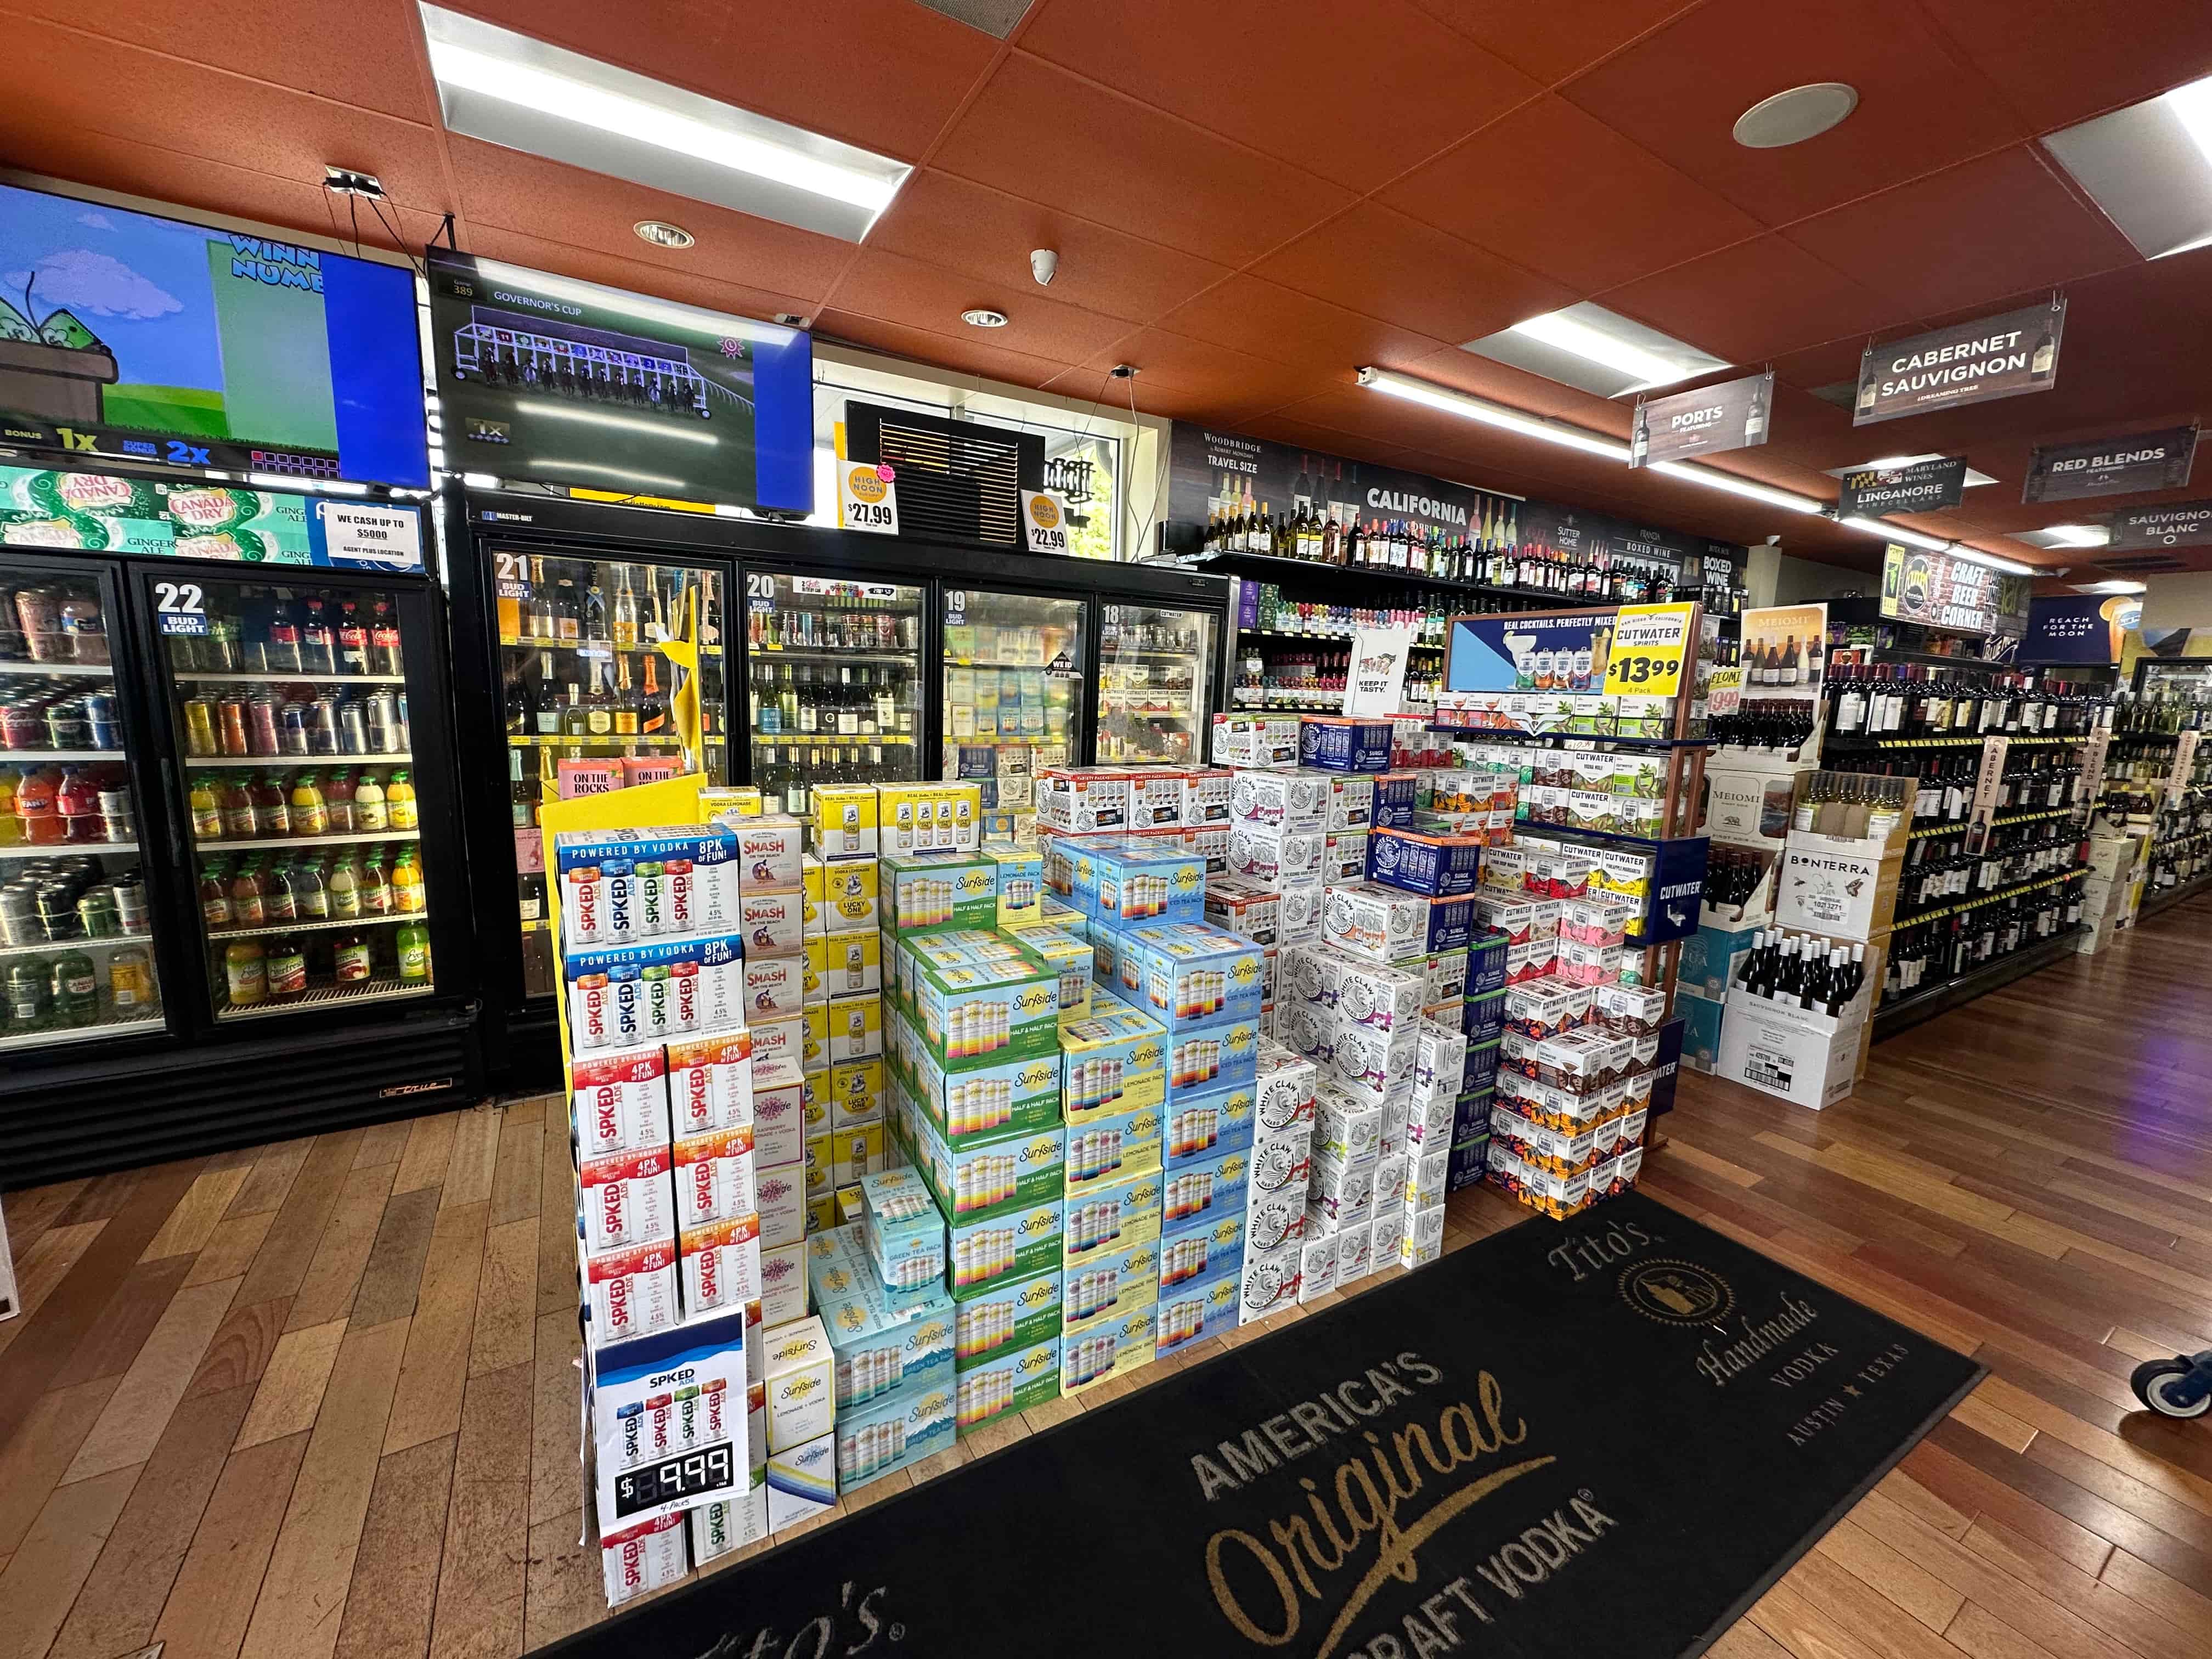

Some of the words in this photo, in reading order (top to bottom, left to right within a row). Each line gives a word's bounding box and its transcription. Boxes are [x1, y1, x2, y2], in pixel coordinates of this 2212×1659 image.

[453, 285, 473, 296] 389
[494, 291, 560, 312] GOVERNOR'S
[562, 306, 582, 316] CUP
[1892, 330, 2022, 374] CABERNET
[1881, 352, 2027, 397] SAUVIGNON
[1672, 405, 1723, 428] PORTS
[4, 429, 42, 439] BONUS
[1679, 421, 1712, 433] FEATURING
[123, 441, 156, 449] SUPER
[123, 447, 157, 455] BONUS
[1204, 432, 1261, 453] WOODBRIDGE
[1207, 454, 1239, 470] TRAVEL
[1239, 461, 1258, 474] SIZE
[1905, 461, 1957, 474] MARYLAND
[2052, 459, 2087, 472] RED
[2091, 448, 2166, 467] BLENDS
[855, 476, 881, 485] HIGH
[1905, 473, 1934, 482] WINES
[61, 481, 132, 499] CANADA
[853, 484, 883, 493] NOON
[1857, 484, 1944, 503] LINGANORE
[168, 496, 237, 514] CANADA
[1034, 504, 1054, 512] HIGH
[1367, 488, 1466, 526] CALIFORNIA
[191, 508, 224, 521] DRY
[337, 514, 352, 523] WE
[354, 515, 377, 526] CASH
[379, 517, 392, 527] UP
[393, 518, 404, 528] TO
[848, 503, 892, 525] $27.99
[1034, 511, 1056, 520] NOON
[2129, 510, 2212, 525] SAUVIGNO
[357, 528, 388, 539] $5000
[1558, 526, 1580, 538] SUTTER
[2146, 523, 2199, 535] BLANC
[127, 537, 175, 548] GINGER
[1031, 528, 1065, 548] $22.99
[1559, 536, 1577, 546] HOME
[377, 548, 404, 556] LOCATION
[1627, 542, 1651, 555] BOXED
[1653, 546, 1671, 558] WINE
[496, 552, 529, 580] 21
[1703, 556, 1731, 573] BOXED
[1706, 570, 1729, 586] WINE
[1951, 561, 1987, 587] CRAFT
[498, 589, 530, 597] LIGHT
[747, 574, 774, 598] 20
[155, 583, 204, 613] 22
[945, 591, 966, 612] 19
[1951, 583, 1979, 607] BEER
[167, 616, 199, 625] BUD
[1103, 605, 1119, 623] 18
[1160, 610, 1183, 618] CUTWATER
[1758, 616, 1808, 627] MEIOMI
[1940, 605, 1984, 630] CORNER
[163, 623, 206, 634] LIGHT
[1504, 622, 1519, 630] REAL
[1519, 619, 1555, 629] COCKTAILS.
[1556, 617, 1592, 628] PERFECTLY
[1617, 628, 1681, 640] CUTWATER
[1711, 670, 1742, 684] EIOMI
[1576, 753, 1614, 763] CUTWATER
[1982, 739, 2000, 799] CABERNET
[574, 774, 590, 783] ON
[591, 774, 608, 783] THE
[574, 783, 610, 793] ROCKS
[1712, 790, 1760, 803] MEIOMI
[572, 845, 628, 859] POWERED
[634, 845, 647, 854] BY
[652, 842, 689, 853] VODKA
[698, 838, 724, 854] 8PK
[743, 838, 785, 855] SMASH
[698, 854, 706, 862] OF
[707, 850, 727, 862] FUN!
[1489, 849, 1522, 861] CUTWATER
[1605, 853, 1644, 866] CUTWATER
[1376, 866, 1394, 876] SURGE
[1790, 855, 1870, 876] BONTERRA
[627, 877, 635, 896] ADE
[956, 875, 995, 890] Surfside
[1660, 881, 1702, 900] CUTWATER
[579, 884, 596, 931] SPKED
[611, 879, 630, 930] SPKED
[1543, 996, 1567, 1010] CUTWATER
[1748, 1001, 1785, 1015] SAUVIGNON
[1787, 1013, 1809, 1022] BLANC
[1222, 1030, 1257, 1047] Surfside
[1126, 1047, 1165, 1065] Surfside
[631, 1060, 652, 1075] 4PK
[1259, 1085, 1275, 1116] WHITE
[1275, 1079, 1299, 1093] CLAW
[596, 1086, 617, 1139] SPKED
[889, 1251, 910, 1261] GREEN
[912, 1248, 925, 1256] TEA
[927, 1244, 943, 1253] PACK
[1547, 1218, 1650, 1282] Tito's
[905, 1323, 953, 1352] Surfside
[1695, 1291, 1818, 1387] Handmade
[1769, 1342, 1838, 1389] VODKA
[649, 1368, 695, 1389] SPKED
[679, 1378, 695, 1386] ADE
[781, 1378, 821, 1400] Surfside
[1786, 1397, 1847, 1447] AUSTIN
[1858, 1342, 1910, 1384] TEXAS
[777, 1407, 804, 1418] LEMONADE
[808, 1397, 826, 1407] VODKA
[1189, 1352, 1444, 1500] AMERICA'S
[660, 1448, 729, 1492] 9.99
[1206, 1369, 1527, 1646] Original
